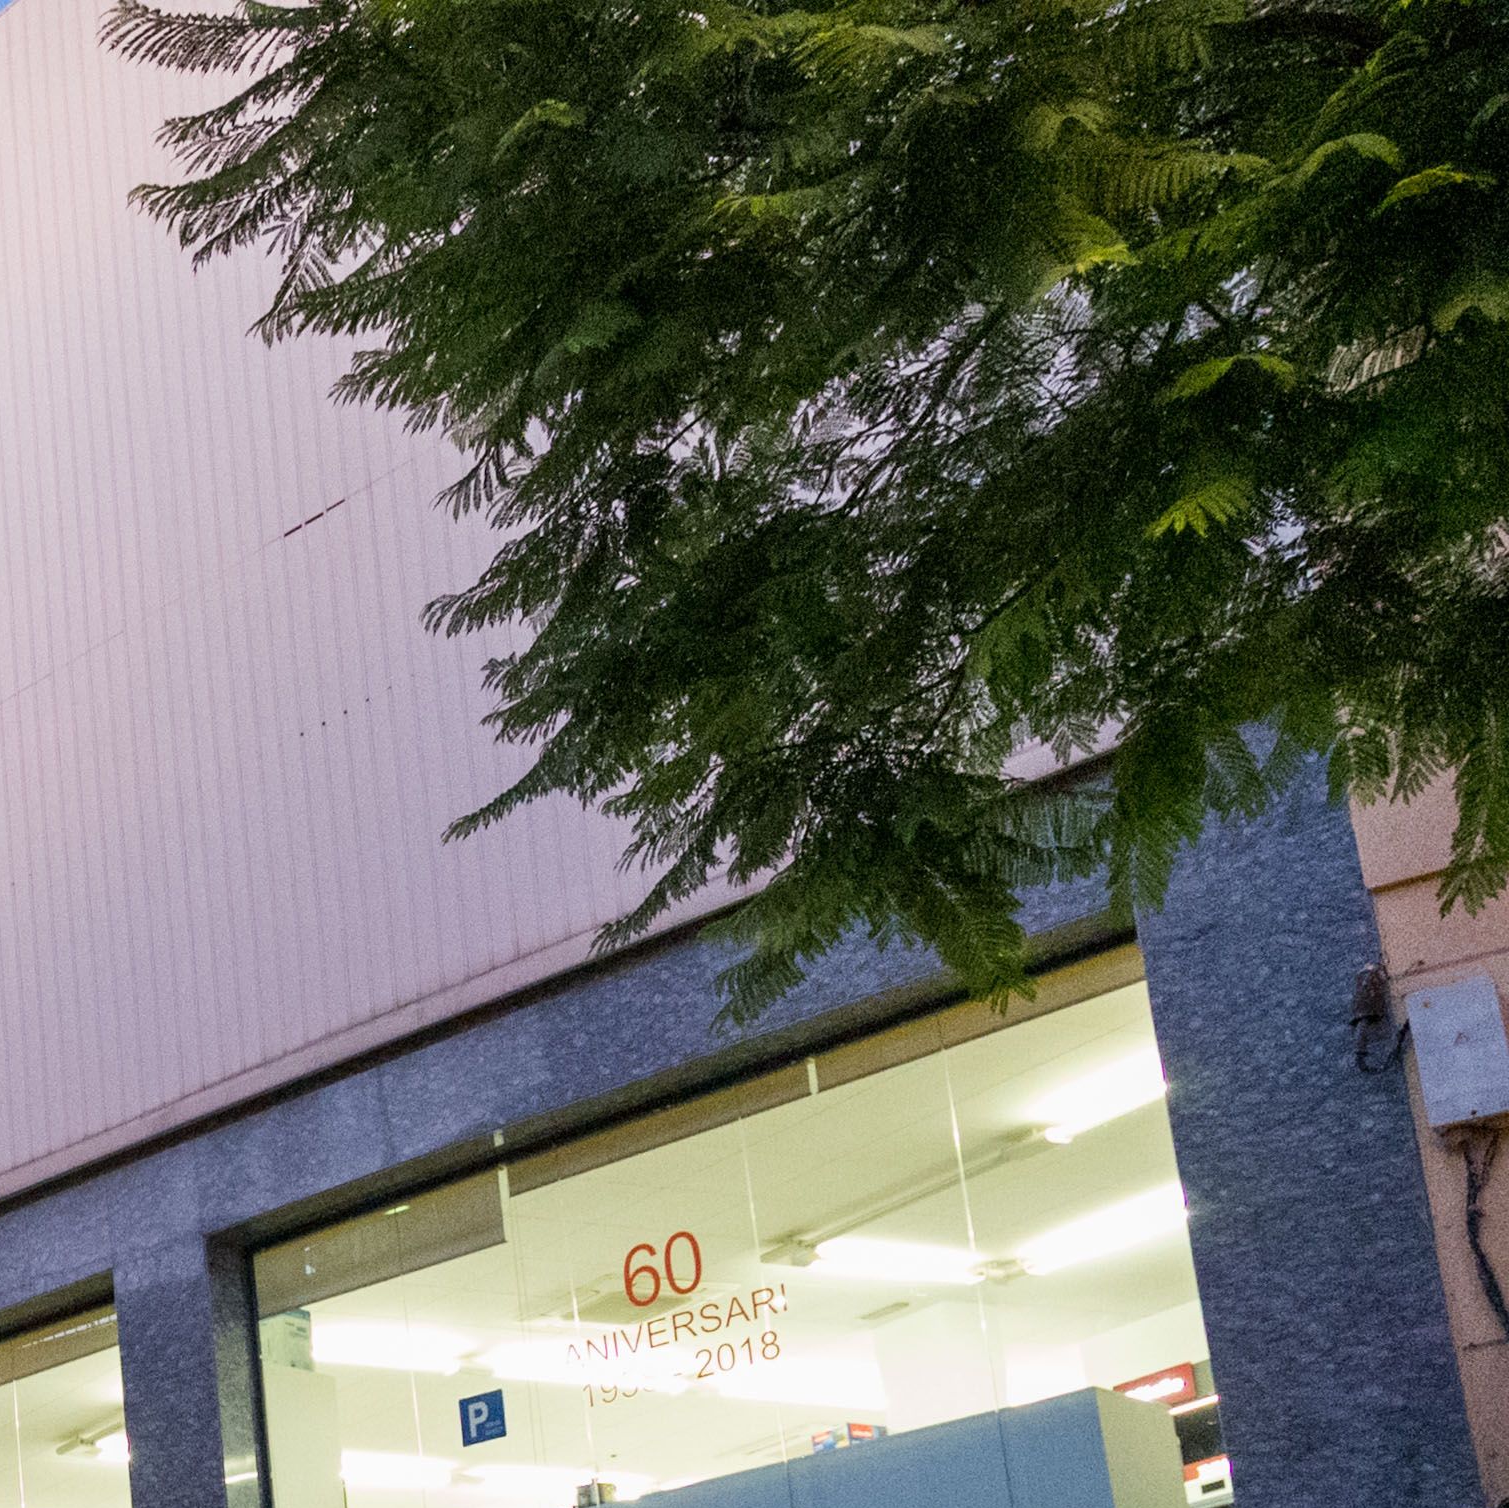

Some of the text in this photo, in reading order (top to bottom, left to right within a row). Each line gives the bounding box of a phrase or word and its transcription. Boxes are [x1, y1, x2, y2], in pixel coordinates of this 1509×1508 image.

[623, 1231, 702, 1308] 60
[694, 1330, 781, 1379] 2018
[468, 1401, 489, 1438] P
